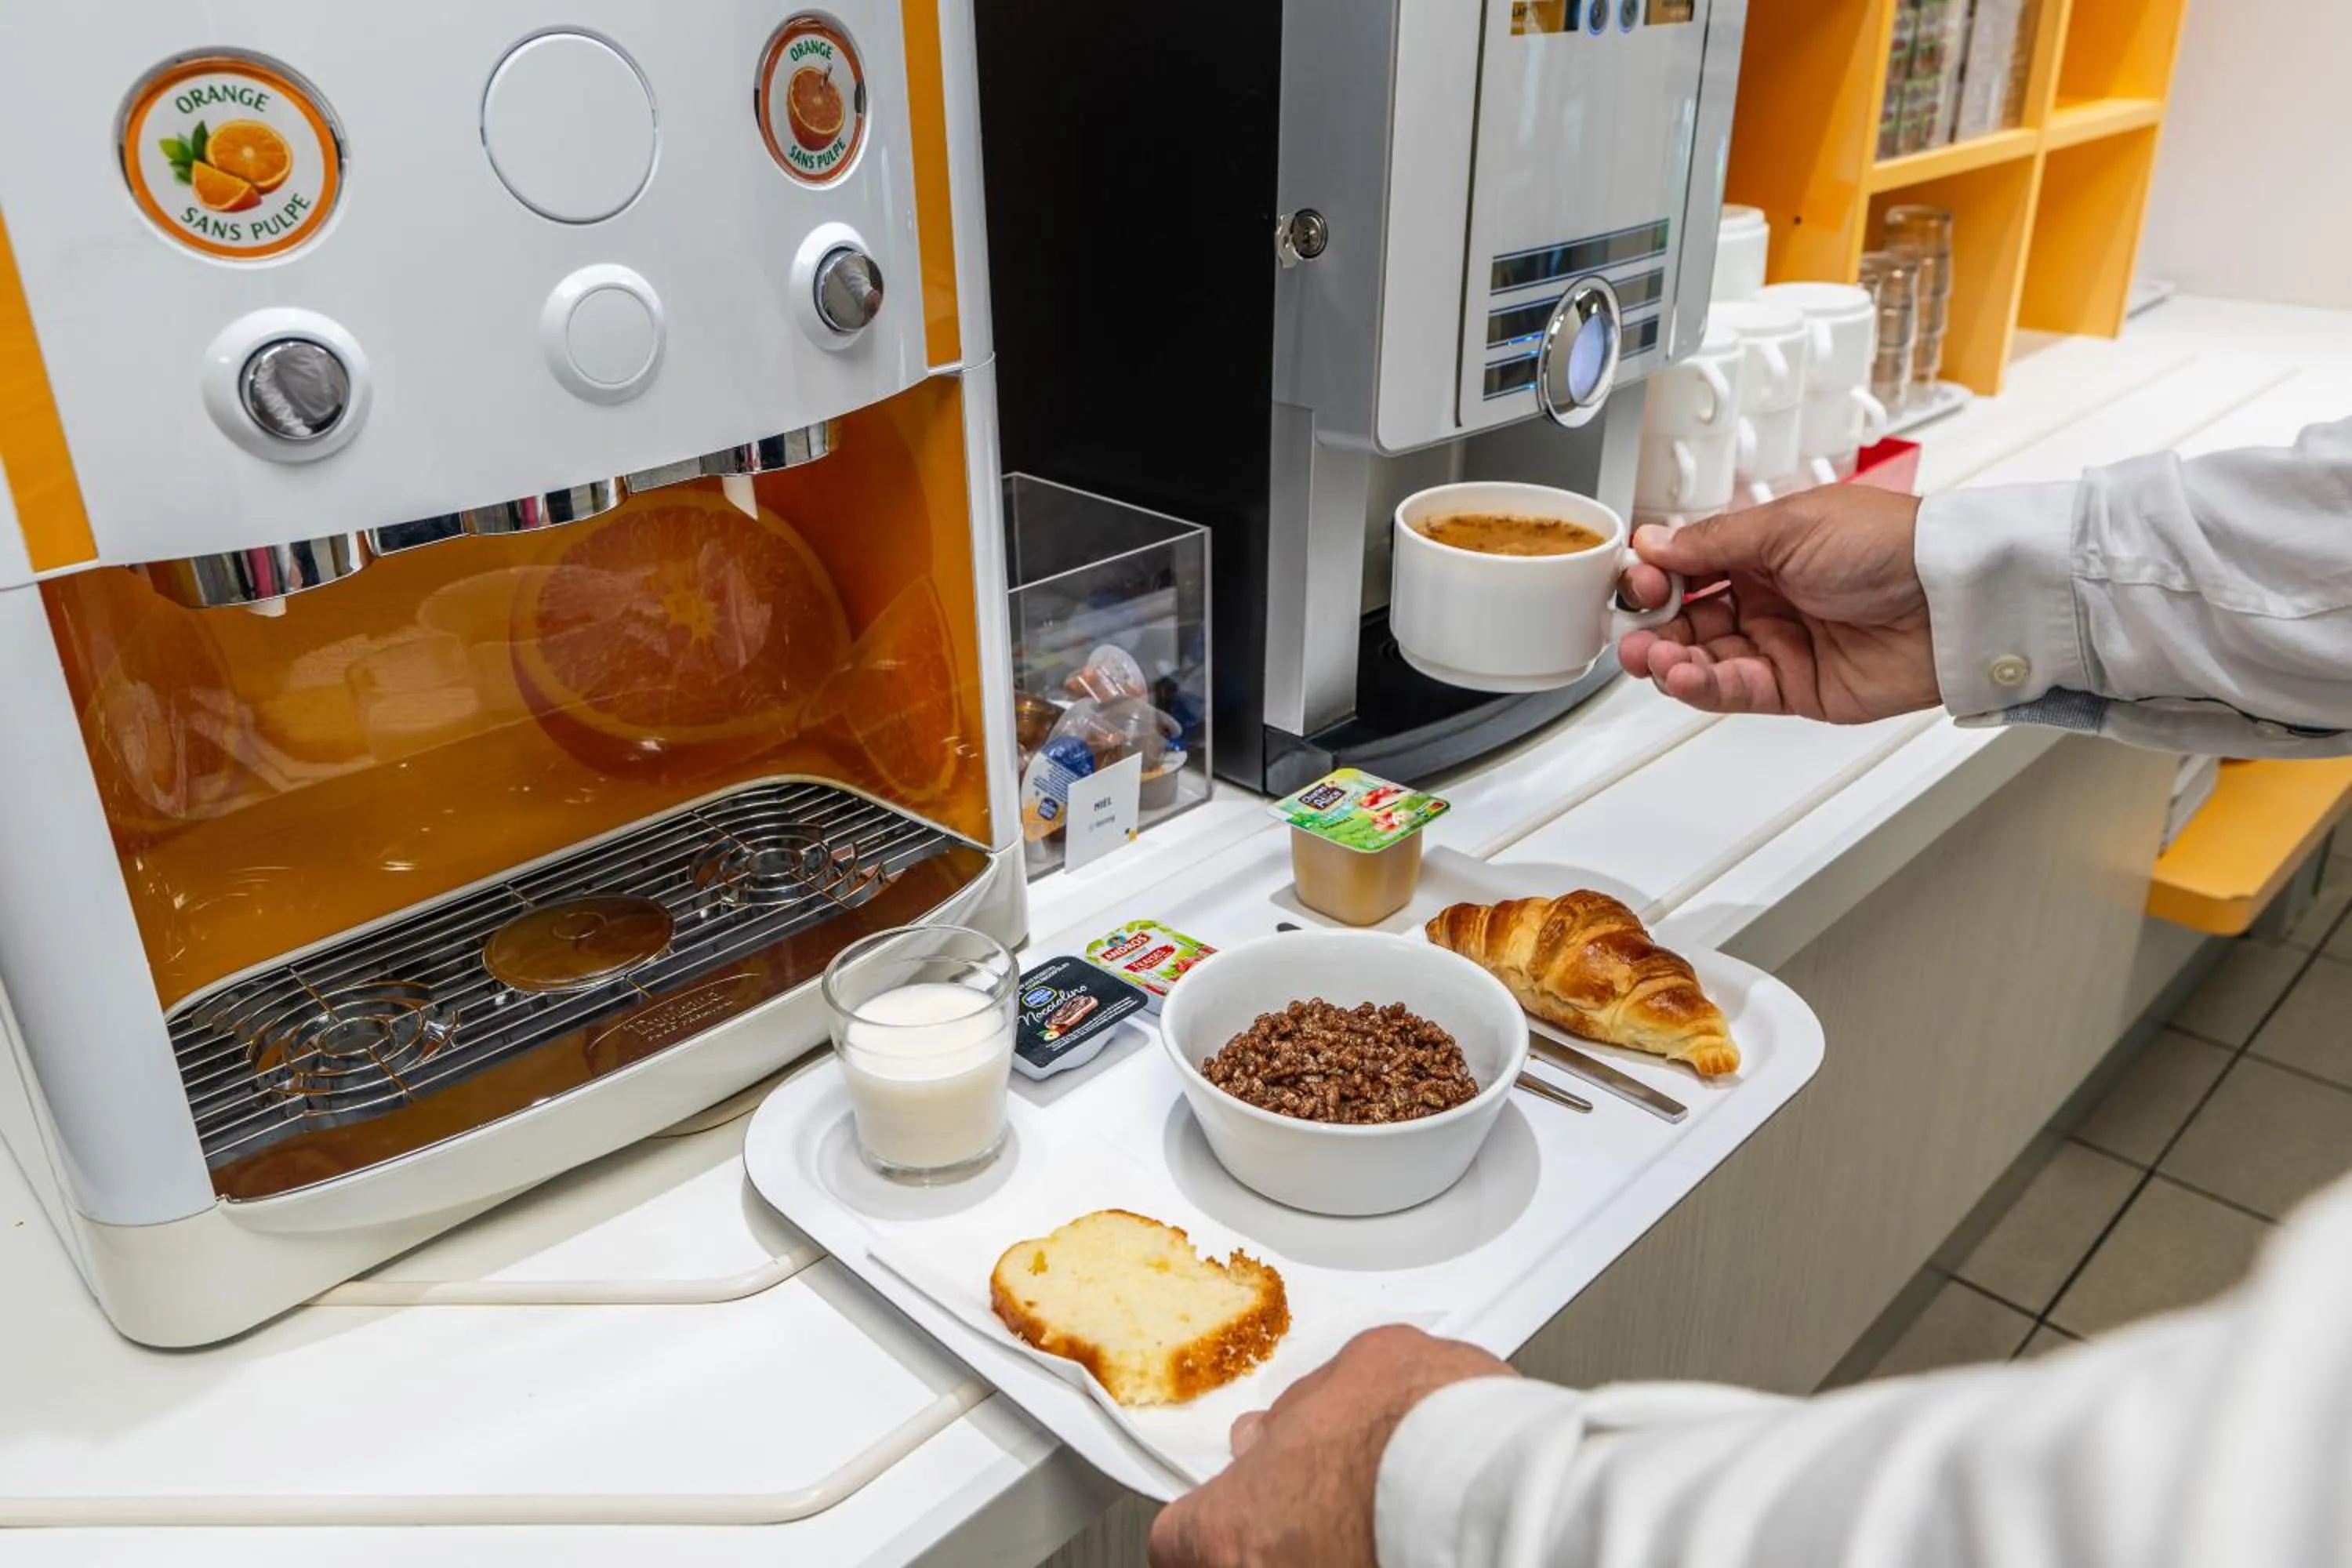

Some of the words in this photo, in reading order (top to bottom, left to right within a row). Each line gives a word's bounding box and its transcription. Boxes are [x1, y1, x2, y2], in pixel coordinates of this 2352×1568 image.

[789, 39, 834, 62] ORANGE
[175, 84, 270, 115] ORANGE
[788, 144, 815, 169] SANS
[817, 137, 847, 169] PULPE
[180, 205, 242, 241] SANS
[250, 192, 311, 241] PULPE
